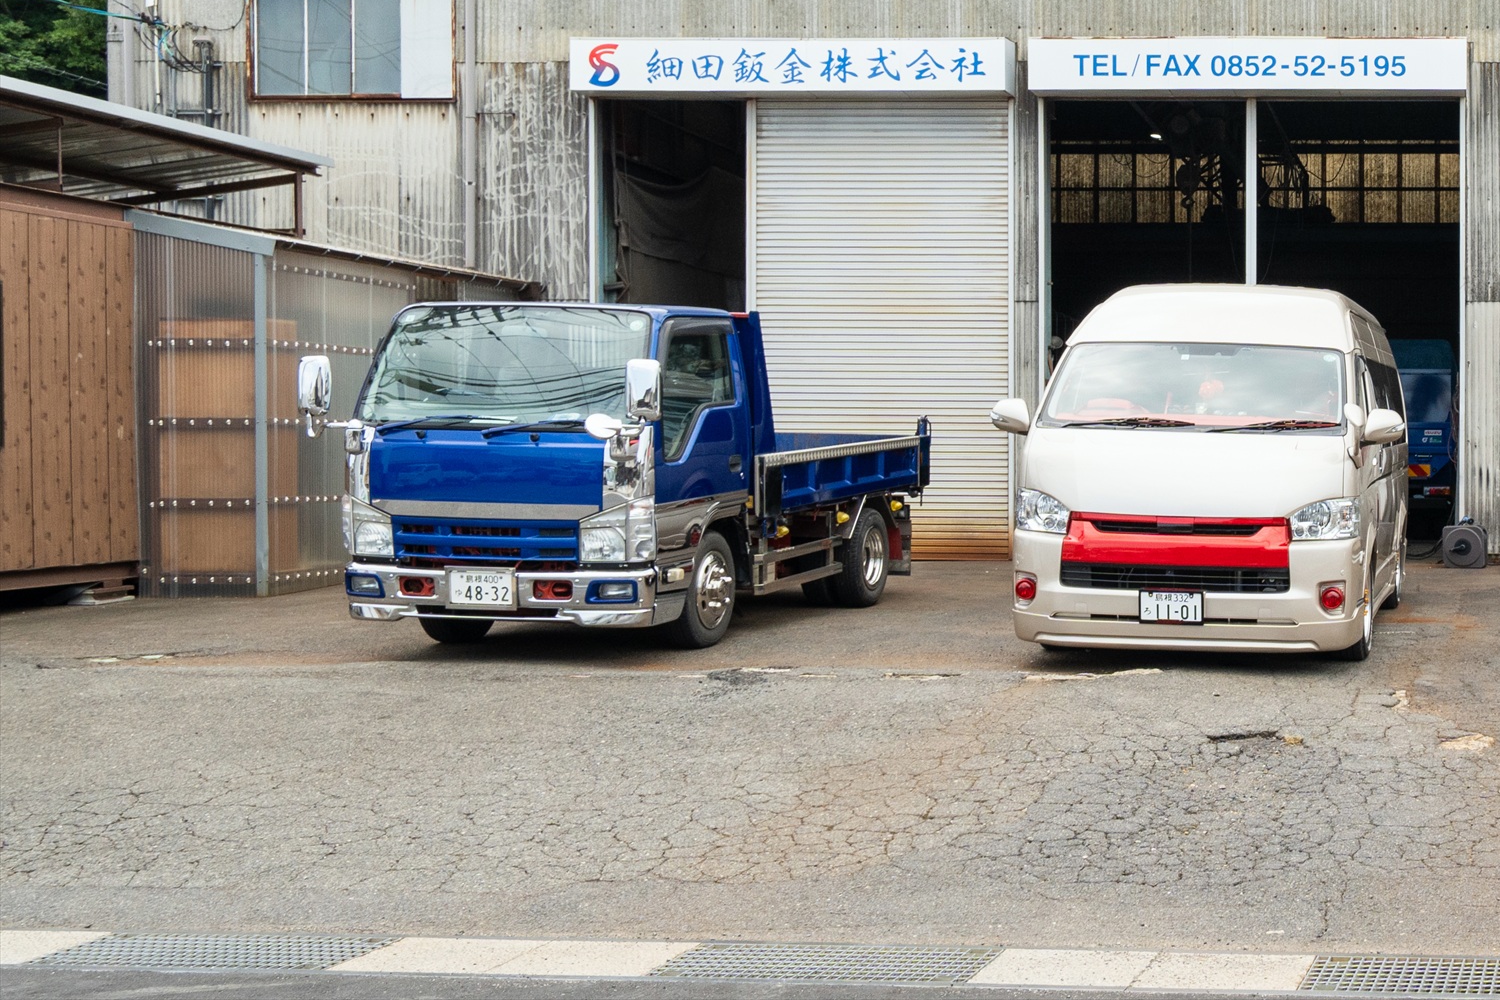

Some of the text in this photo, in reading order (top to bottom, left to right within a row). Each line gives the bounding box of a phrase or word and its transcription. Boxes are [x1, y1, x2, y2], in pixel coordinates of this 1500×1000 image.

[646, 47, 987, 85] 細田鈑金株式会社
[1073, 53, 1407, 77] TEL/FAX 0852-52-5195
[465, 585, 509, 602] 48-32
[1156, 604, 1197, 620] 11-01
